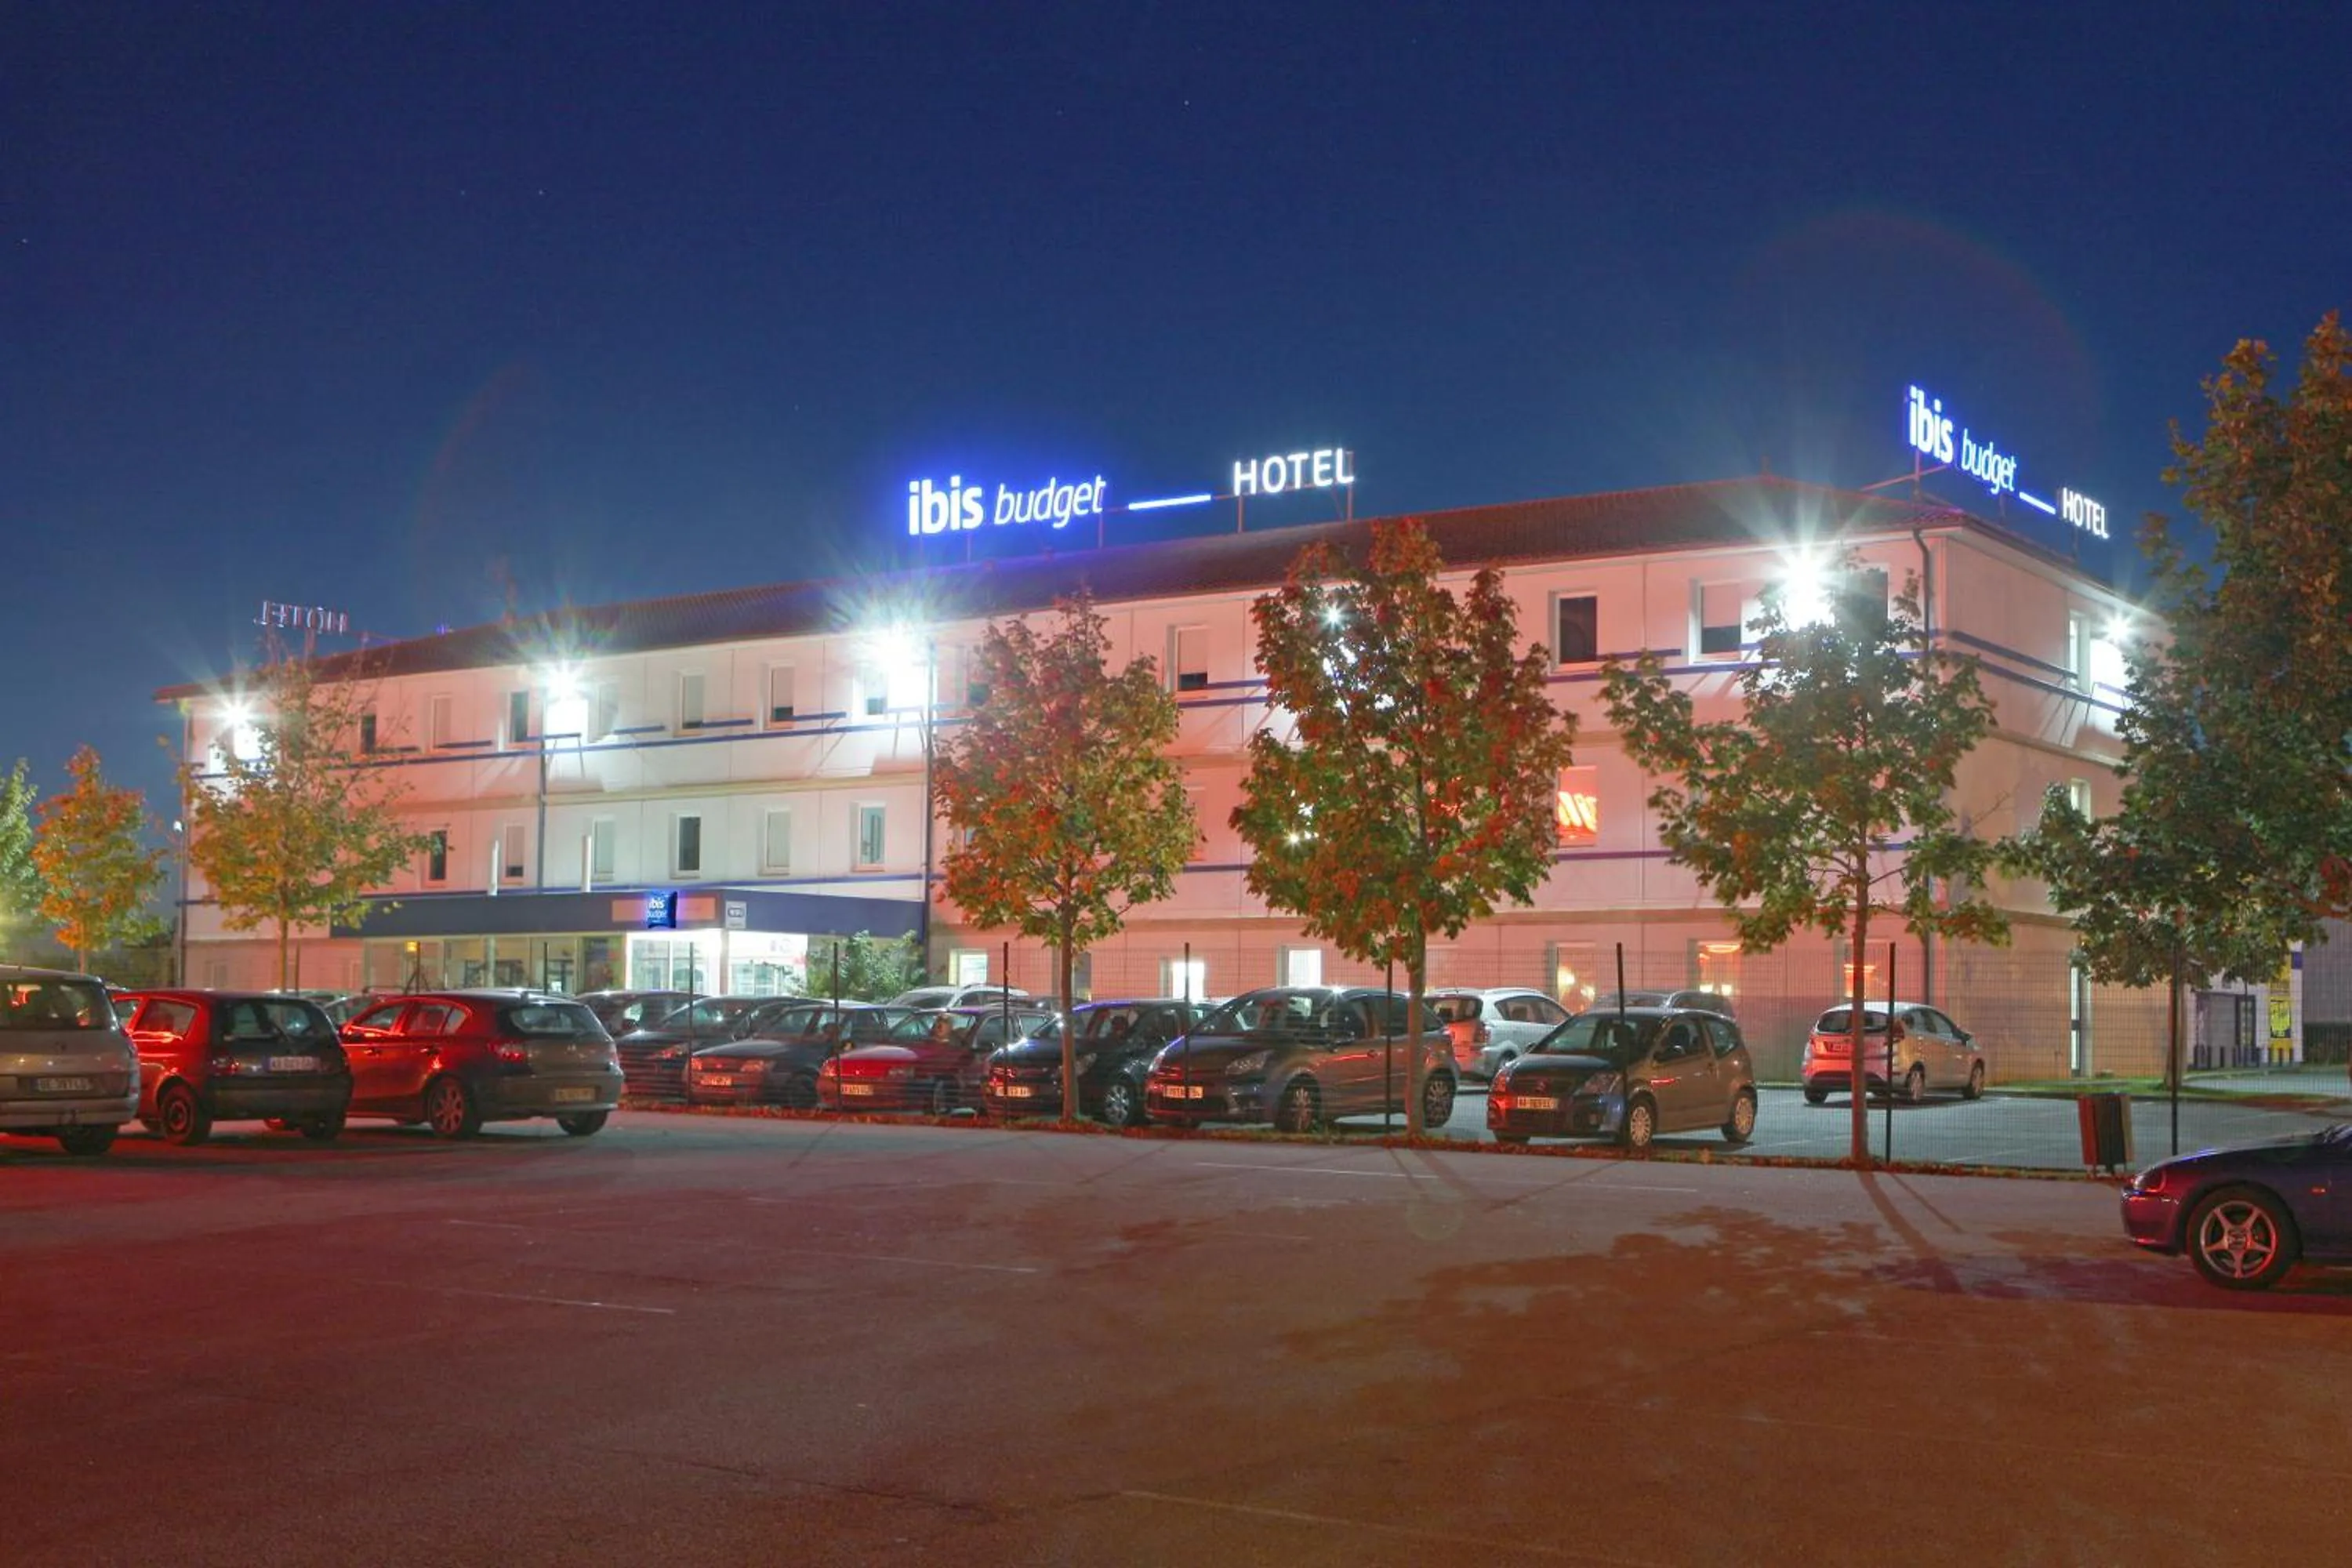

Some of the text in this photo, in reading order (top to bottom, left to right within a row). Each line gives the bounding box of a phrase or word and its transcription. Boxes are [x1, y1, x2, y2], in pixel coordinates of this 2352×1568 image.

[1908, 384, 2111, 540] ibis budget HOTEL
[908, 447, 1356, 536] ibis budget HOTEL
[646, 909, 668, 920] budget
[648, 897, 666, 909] ibis
